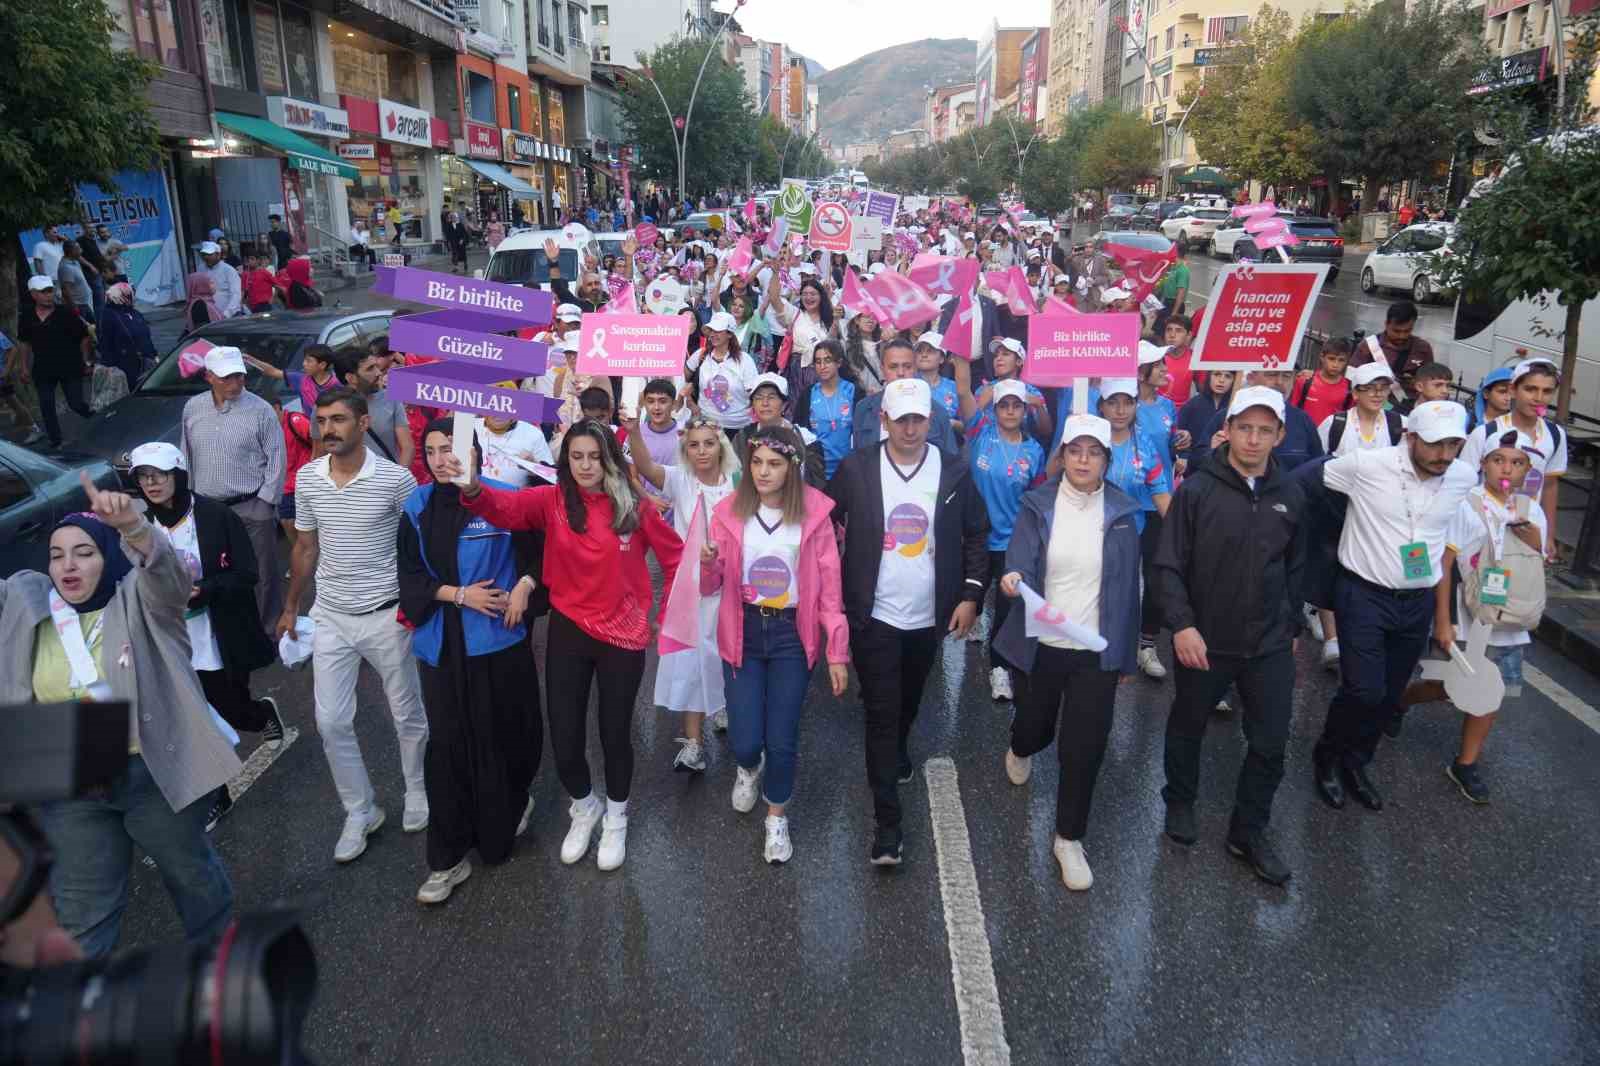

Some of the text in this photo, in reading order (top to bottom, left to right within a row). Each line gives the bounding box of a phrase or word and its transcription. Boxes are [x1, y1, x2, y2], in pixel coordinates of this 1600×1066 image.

[397, 115, 428, 141] arçelik
[427, 281, 524, 312] Biz birlikte
[1233, 288, 1291, 303] İnancını
[1232, 305, 1285, 318] koru ve
[1225, 319, 1282, 335] asla pes
[1054, 329, 1111, 342] Biz birlikte
[1228, 335, 1269, 347] etme.
[438, 335, 504, 361] Güzeliz
[1034, 347, 1070, 360] güzeliz
[607, 357, 637, 368] umut
[415, 382, 517, 414] KADINLAR.
